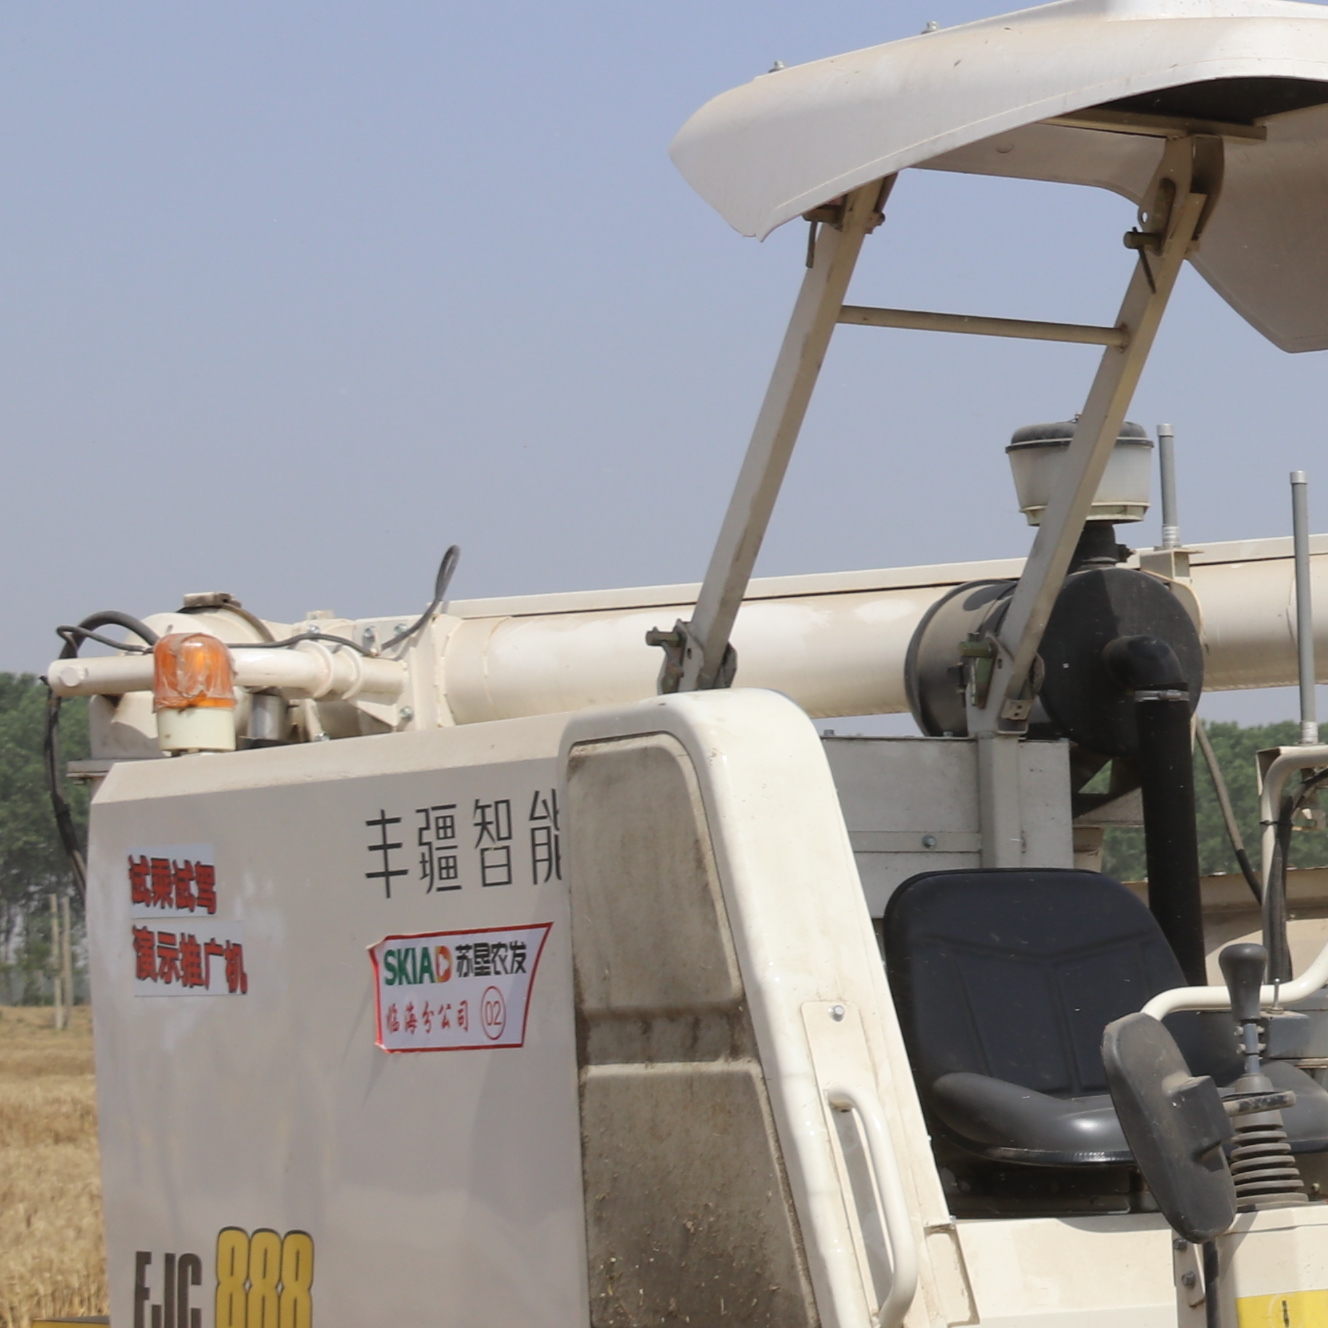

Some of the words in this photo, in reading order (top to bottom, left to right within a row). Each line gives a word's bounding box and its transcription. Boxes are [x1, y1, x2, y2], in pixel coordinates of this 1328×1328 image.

[365, 788, 562, 899] 丰疆智能
[128, 854, 217, 915] 试乘试驾
[132, 924, 248, 995] 演示推广机
[384, 945, 453, 986] SKIAD
[455, 941, 527, 978] 苏垦农发
[386, 999, 469, 1035] 临海分公司
